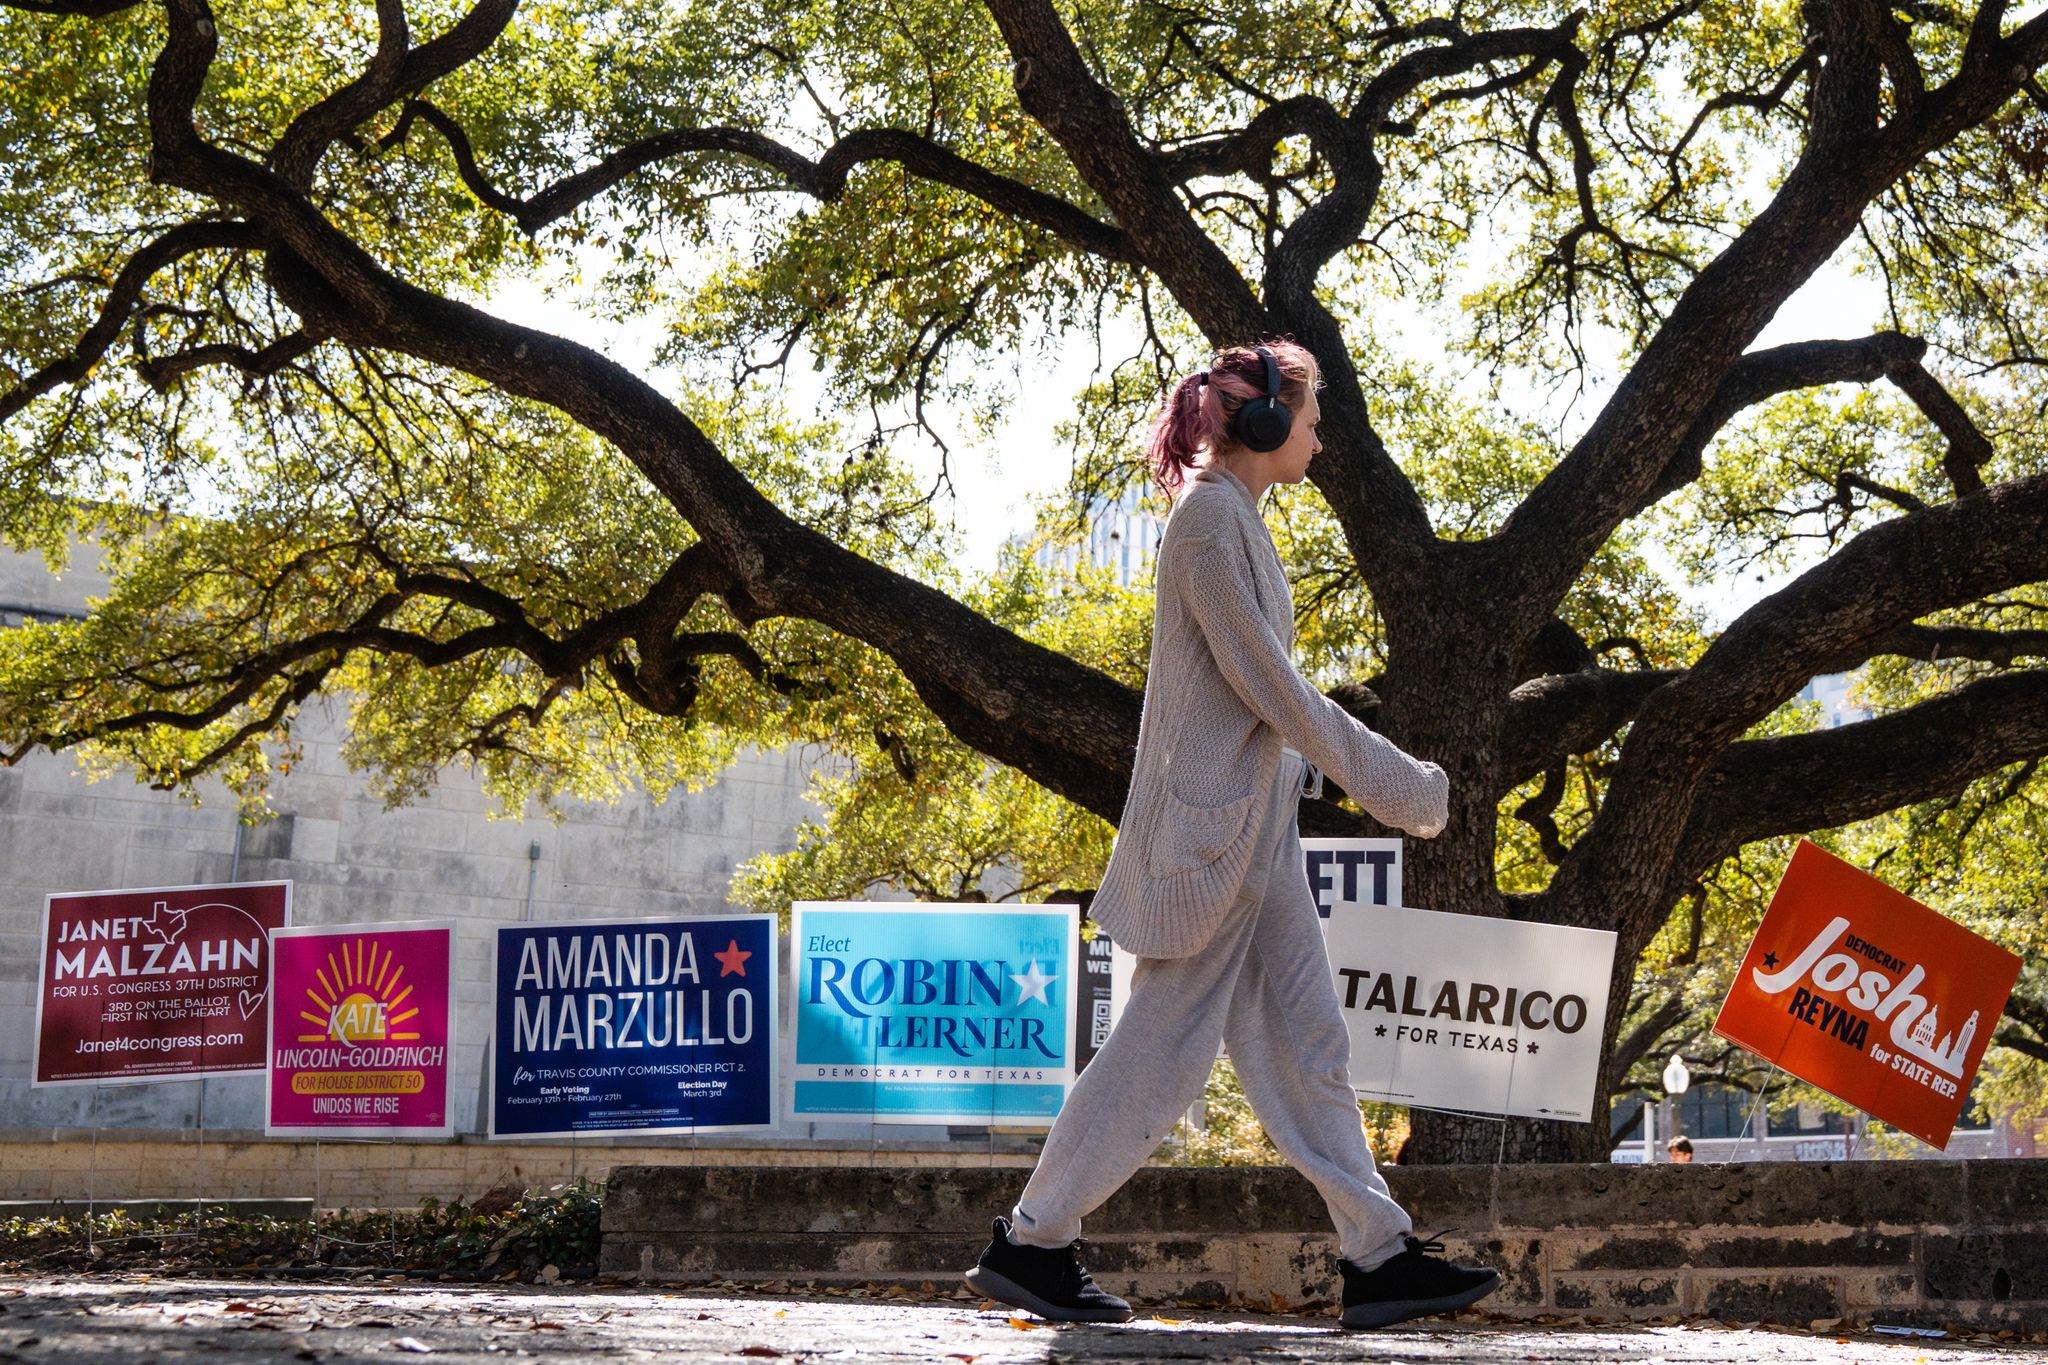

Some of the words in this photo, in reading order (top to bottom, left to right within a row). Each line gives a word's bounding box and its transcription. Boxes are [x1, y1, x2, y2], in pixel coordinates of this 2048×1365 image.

[57, 917, 143, 943] JANET
[808, 935, 852, 952] Elect
[1844, 934, 1907, 975] DEMOCRAT
[55, 937, 260, 980] MALZAHN
[515, 931, 701, 990] AMANDA
[53, 986, 77, 998] FOR
[81, 984, 103, 996] U.S.
[108, 980, 172, 995] CONGRESS
[176, 978, 205, 991] 37TH
[208, 975, 259, 989] DISTRICT
[807, 956, 1007, 1019] ROBIN
[1752, 916, 1936, 1050] Josh
[108, 1002, 133, 1012] 3RD
[136, 1000, 155, 1010] ON
[159, 999, 181, 1009] THE
[1338, 968, 1588, 1034] TALARICO
[101, 1012, 133, 1022] FIRST
[136, 1011, 148, 1020] IN
[152, 1010, 187, 1020] YOUR
[190, 1006, 231, 1017] HEART
[327, 1002, 388, 1048] KATE
[513, 987, 753, 1053] MARZULLO
[1787, 986, 1870, 1051] REYNA
[75, 1032, 244, 1054] Janet4congress.com
[878, 1015, 1062, 1059] LERNER
[1396, 1025, 1439, 1045] FOR
[1448, 1031, 1519, 1053] TEXAS
[275, 1046, 444, 1068] LINCOLN-GOLDFINCH
[295, 1076, 317, 1090] FOR
[317, 1075, 355, 1090] HOUSE
[355, 1074, 404, 1089] DISTRICT
[406, 1074, 421, 1089] 50
[513, 1066, 536, 1085] for
[537, 1068, 576, 1079] TRAVIS
[578, 1066, 626, 1078] COUNTY
[627, 1063, 712, 1076] COMMISSIONER
[714, 1062, 736, 1073] PCT
[818, 1068, 922, 1078] DEMOCRAT
[936, 1069, 971, 1079] FOR
[984, 1070, 1043, 1080] TEXAS
[1869, 1043, 1892, 1064] for
[1891, 1054, 1933, 1086] STATE
[1930, 1074, 1958, 1100] REP.
[540, 1086, 561, 1095] Early
[562, 1086, 590, 1095] Voting
[677, 1081, 711, 1089] Election
[711, 1080, 728, 1089] Day
[709, 1089, 722, 1097] 3rd
[313, 1097, 352, 1114] UNIDOS
[354, 1097, 371, 1114] WE
[373, 1097, 399, 1113] RISE
[507, 1096, 543, 1105] February
[544, 1095, 561, 1103] 17th
[567, 1094, 603, 1103] February
[604, 1093, 622, 1101] 27th
